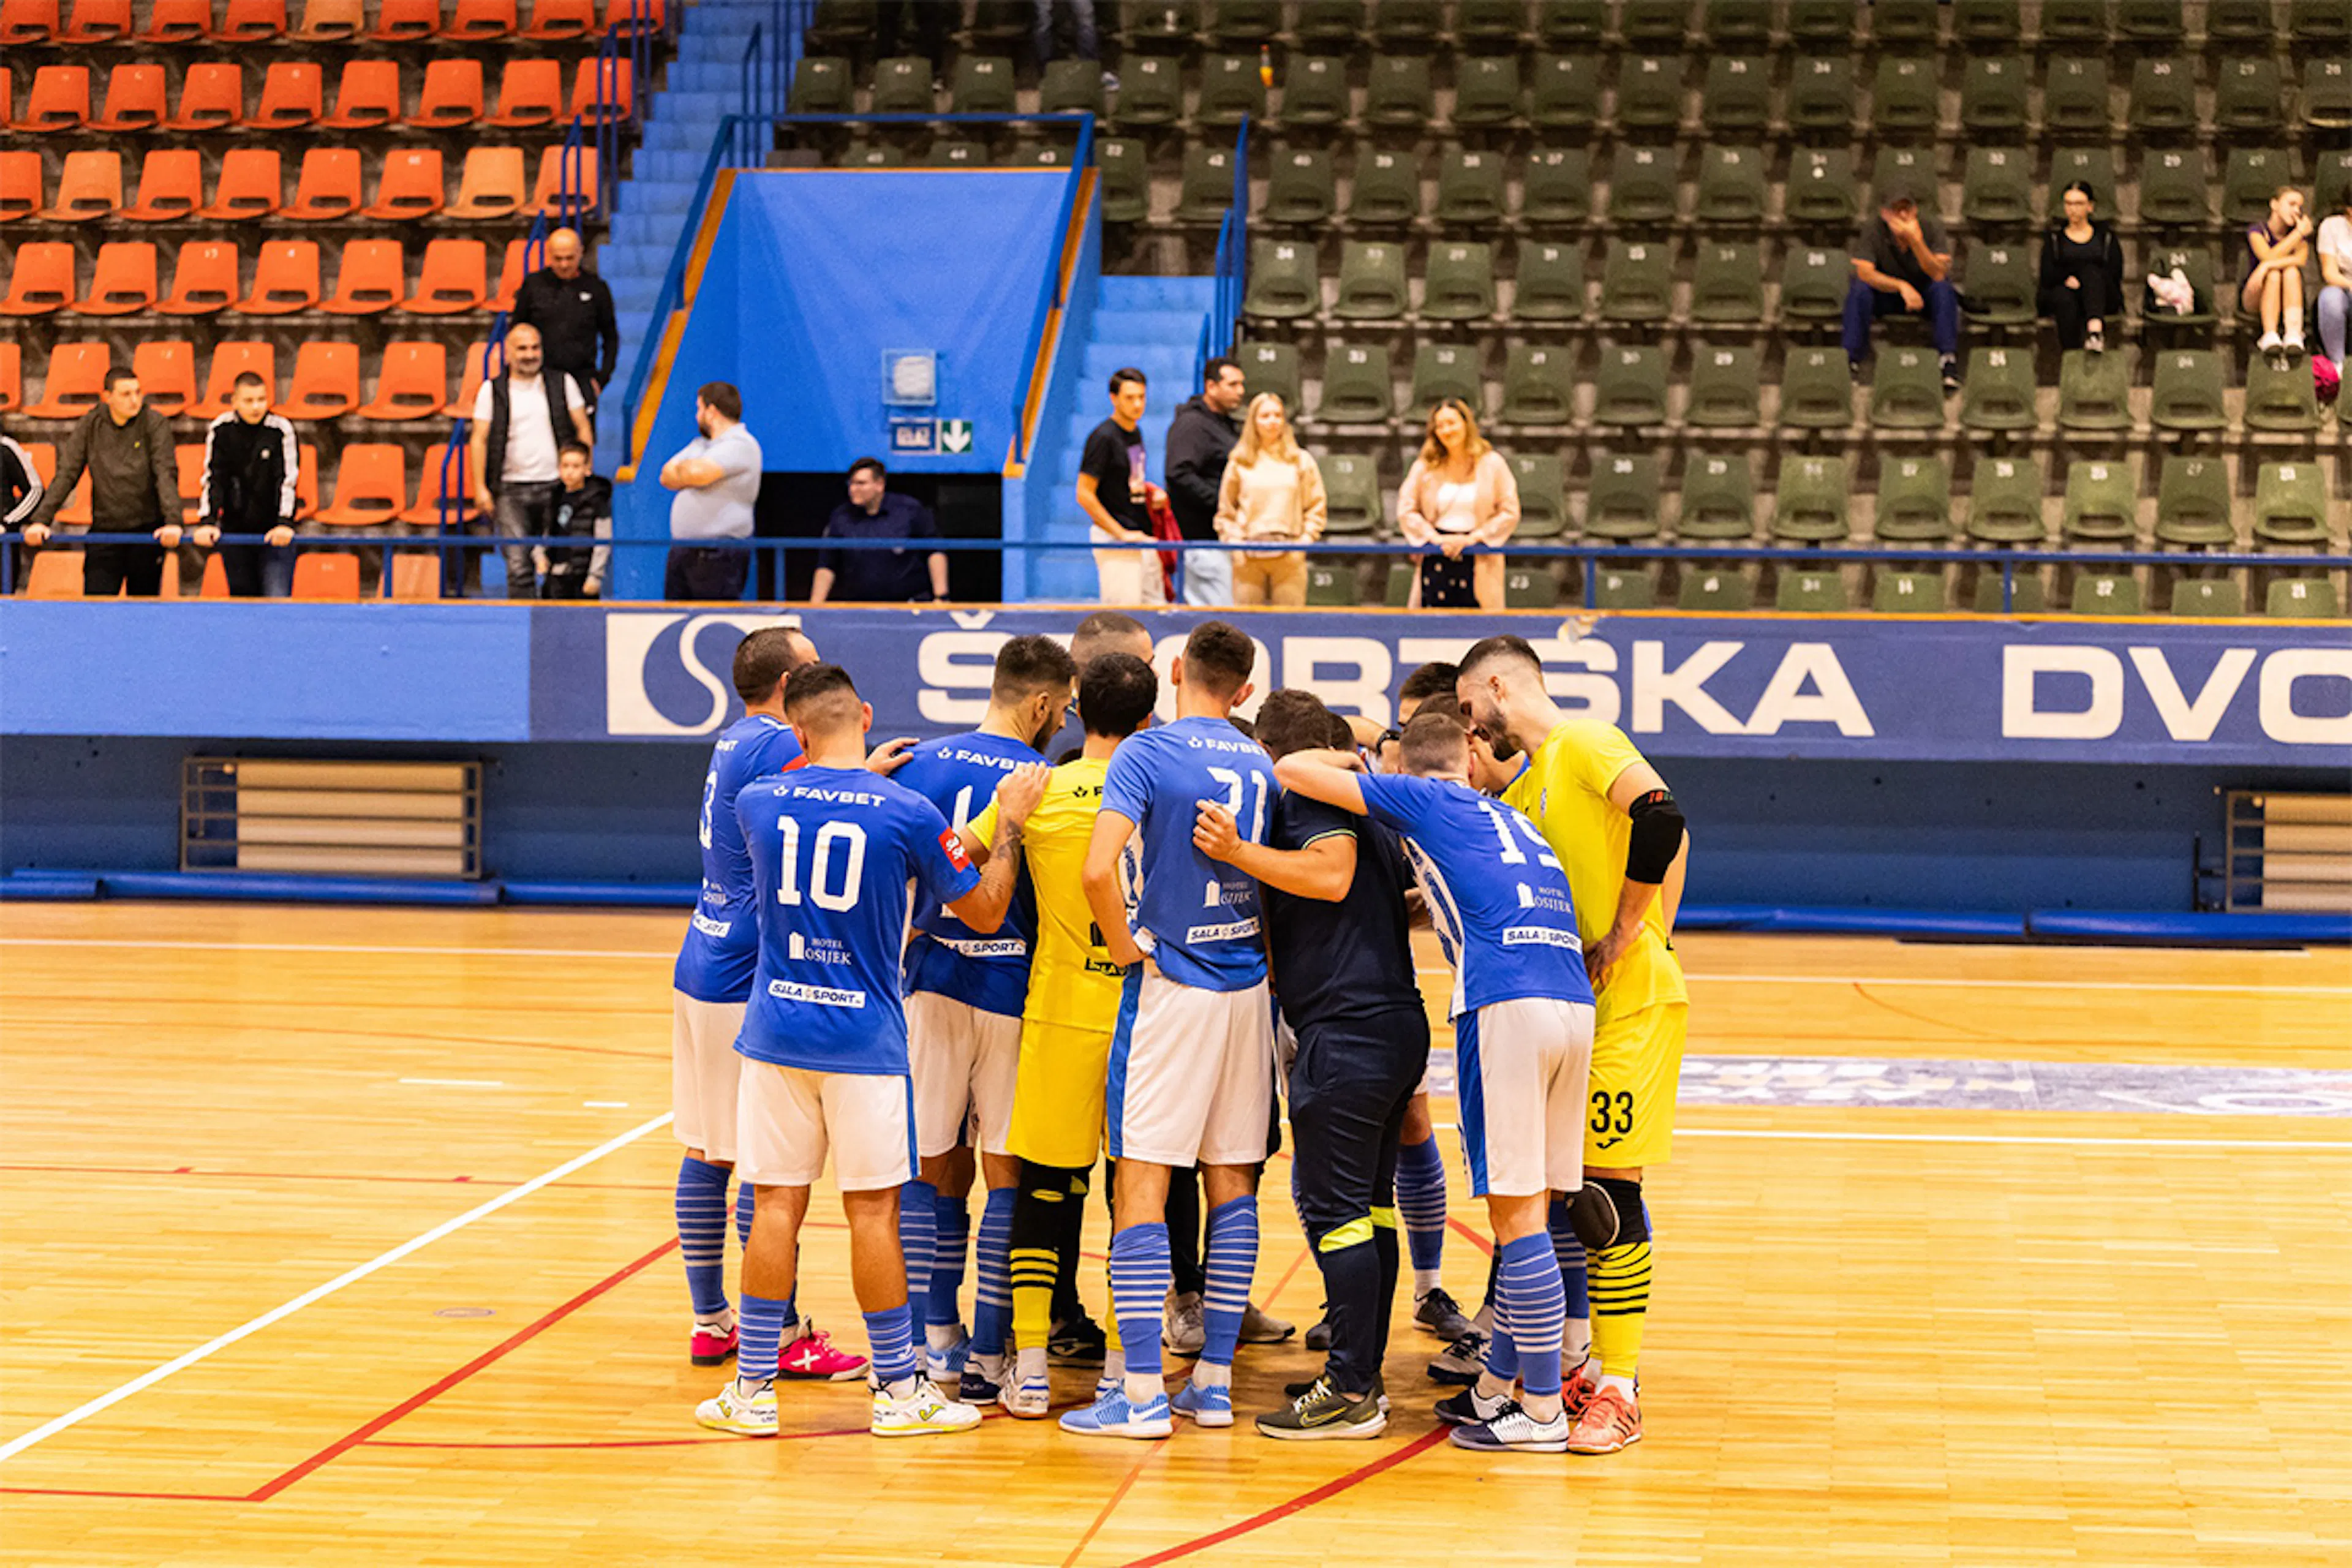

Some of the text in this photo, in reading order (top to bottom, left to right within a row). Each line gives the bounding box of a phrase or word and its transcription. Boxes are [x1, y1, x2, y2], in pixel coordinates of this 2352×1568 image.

[2002, 644, 2352, 744] DVO
[793, 786, 887, 808] FAVBET
[777, 815, 868, 913] 10
[1191, 927, 1219, 940] SALA
[1507, 930, 1539, 941] SALA
[973, 942, 1016, 953] SPORT
[805, 948, 853, 966] OSIJEK
[813, 990, 856, 1003] SPORT
[1590, 1090, 1633, 1134] 33
